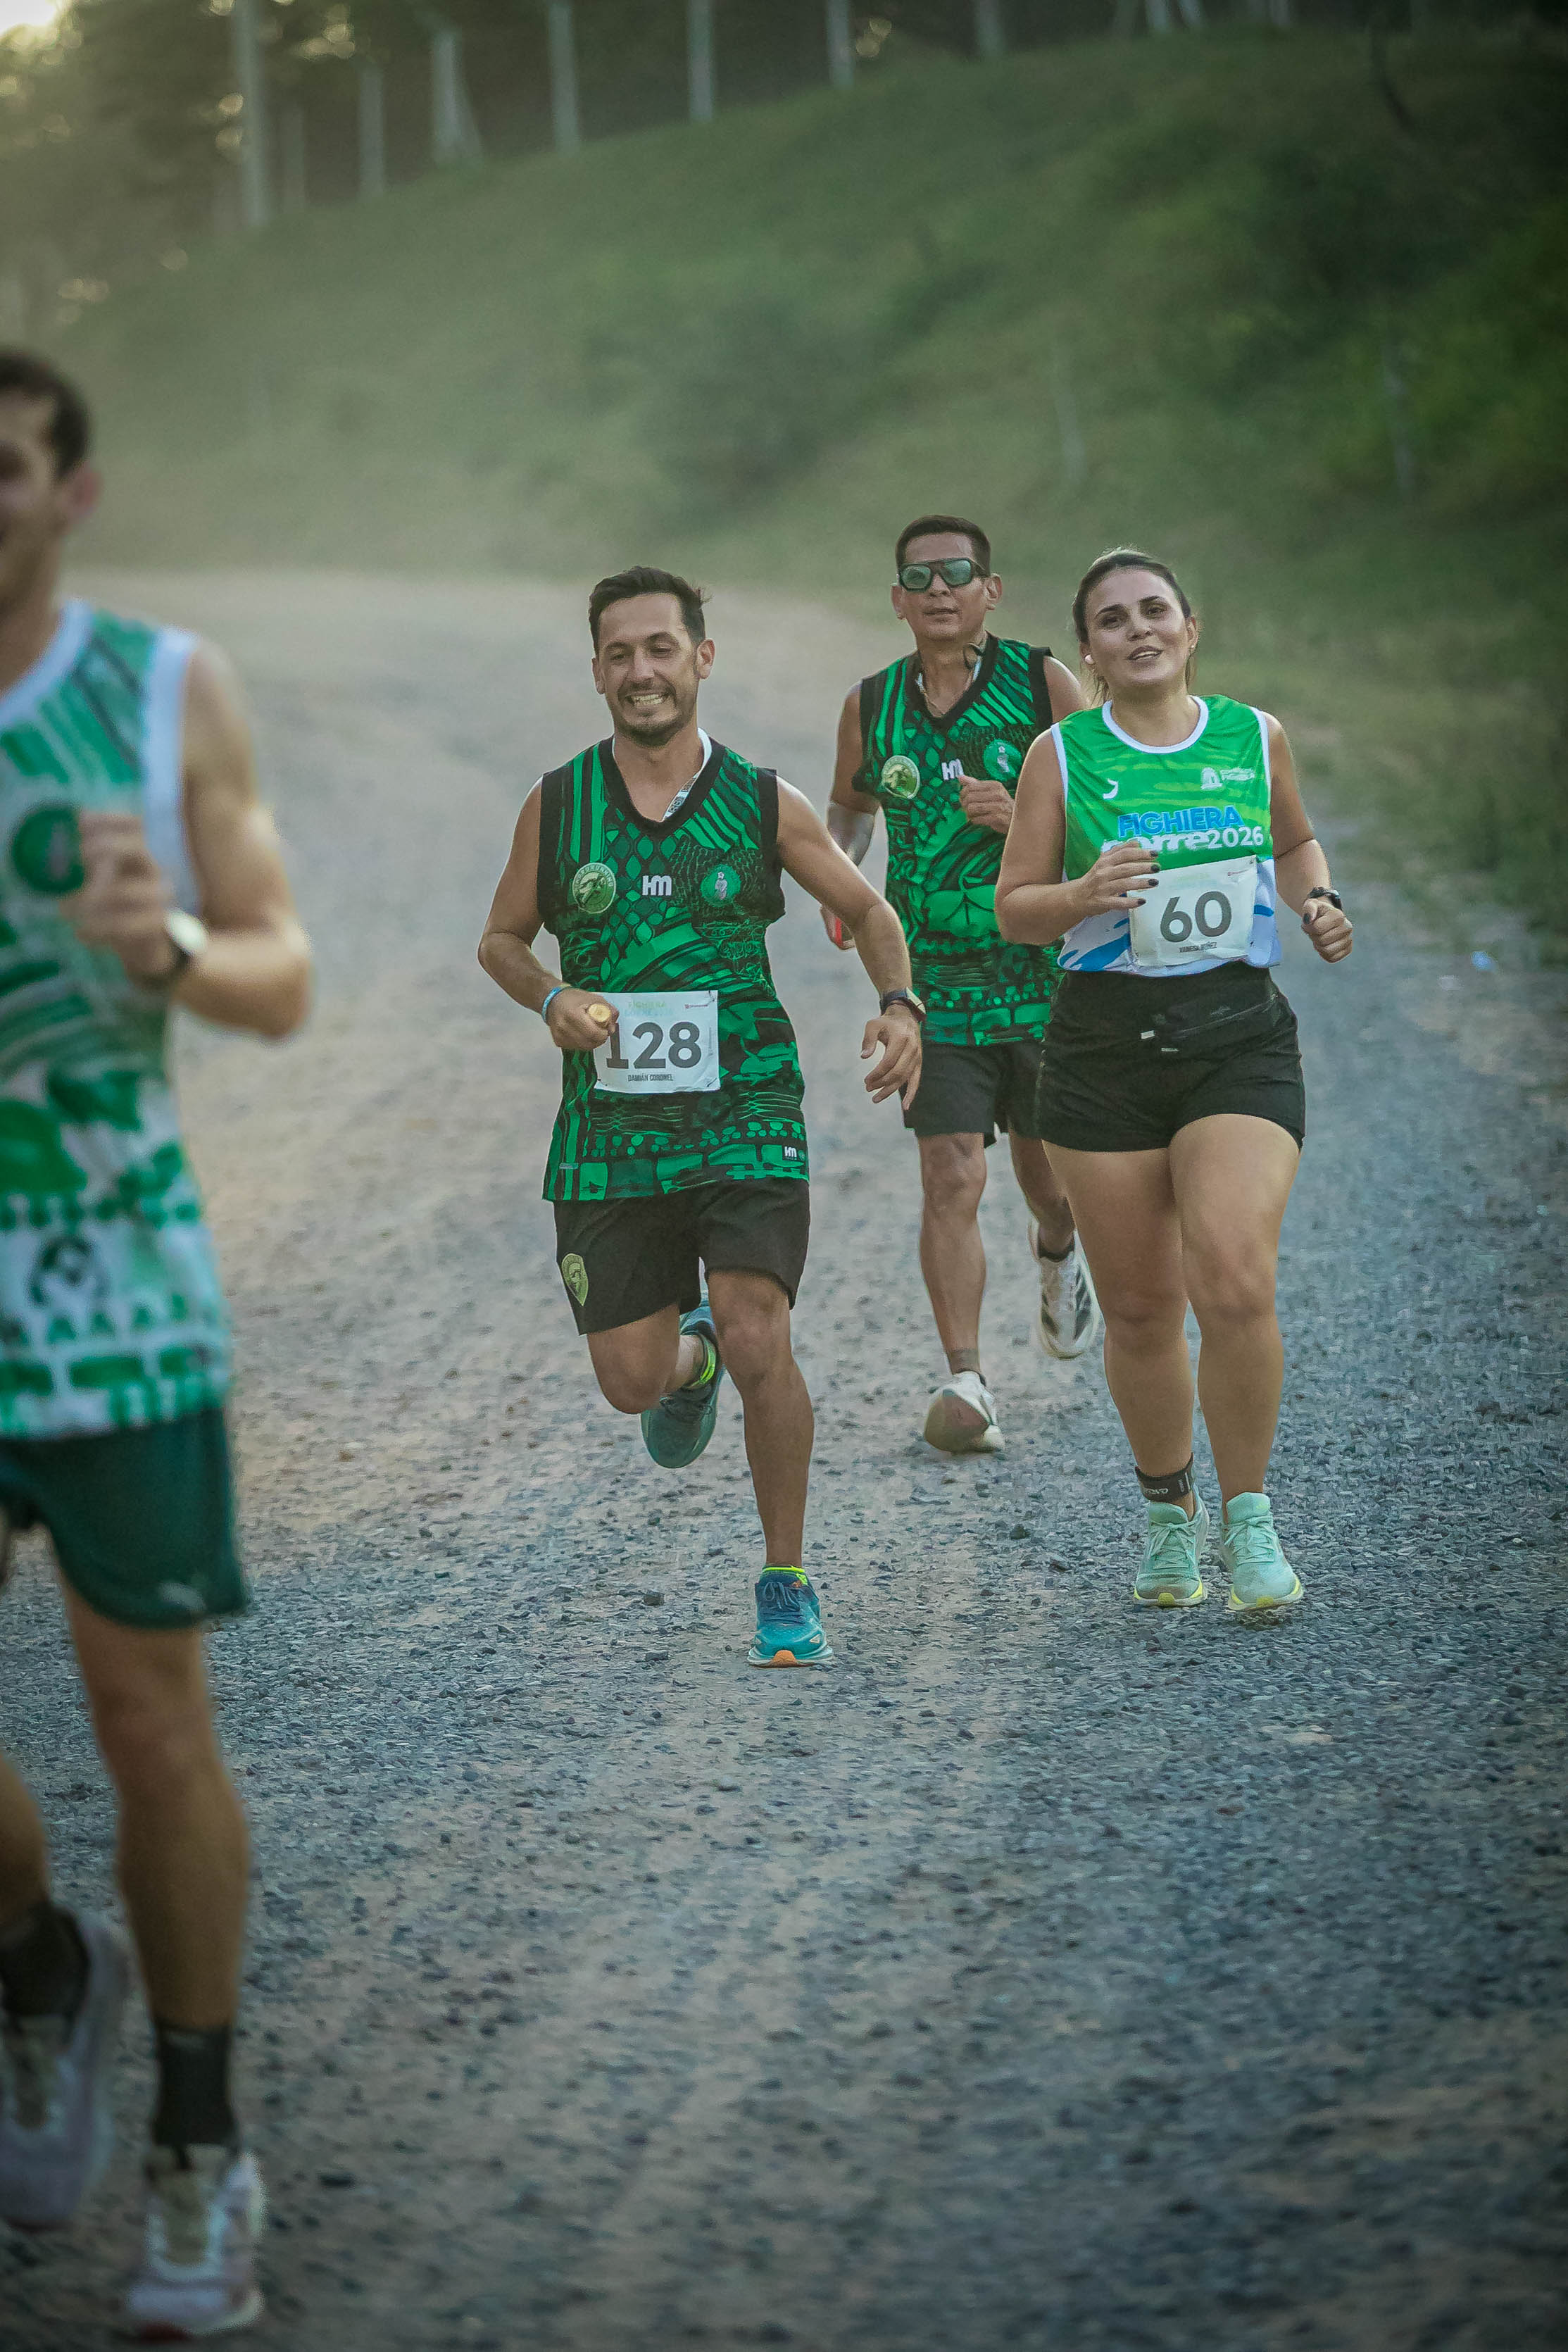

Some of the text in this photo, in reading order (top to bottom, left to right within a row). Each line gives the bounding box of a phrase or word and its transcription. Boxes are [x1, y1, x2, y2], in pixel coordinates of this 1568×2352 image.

[1117, 805, 1246, 839] FIGHIERA
[1160, 891, 1232, 943] 60
[606, 1021, 702, 1070] 128
